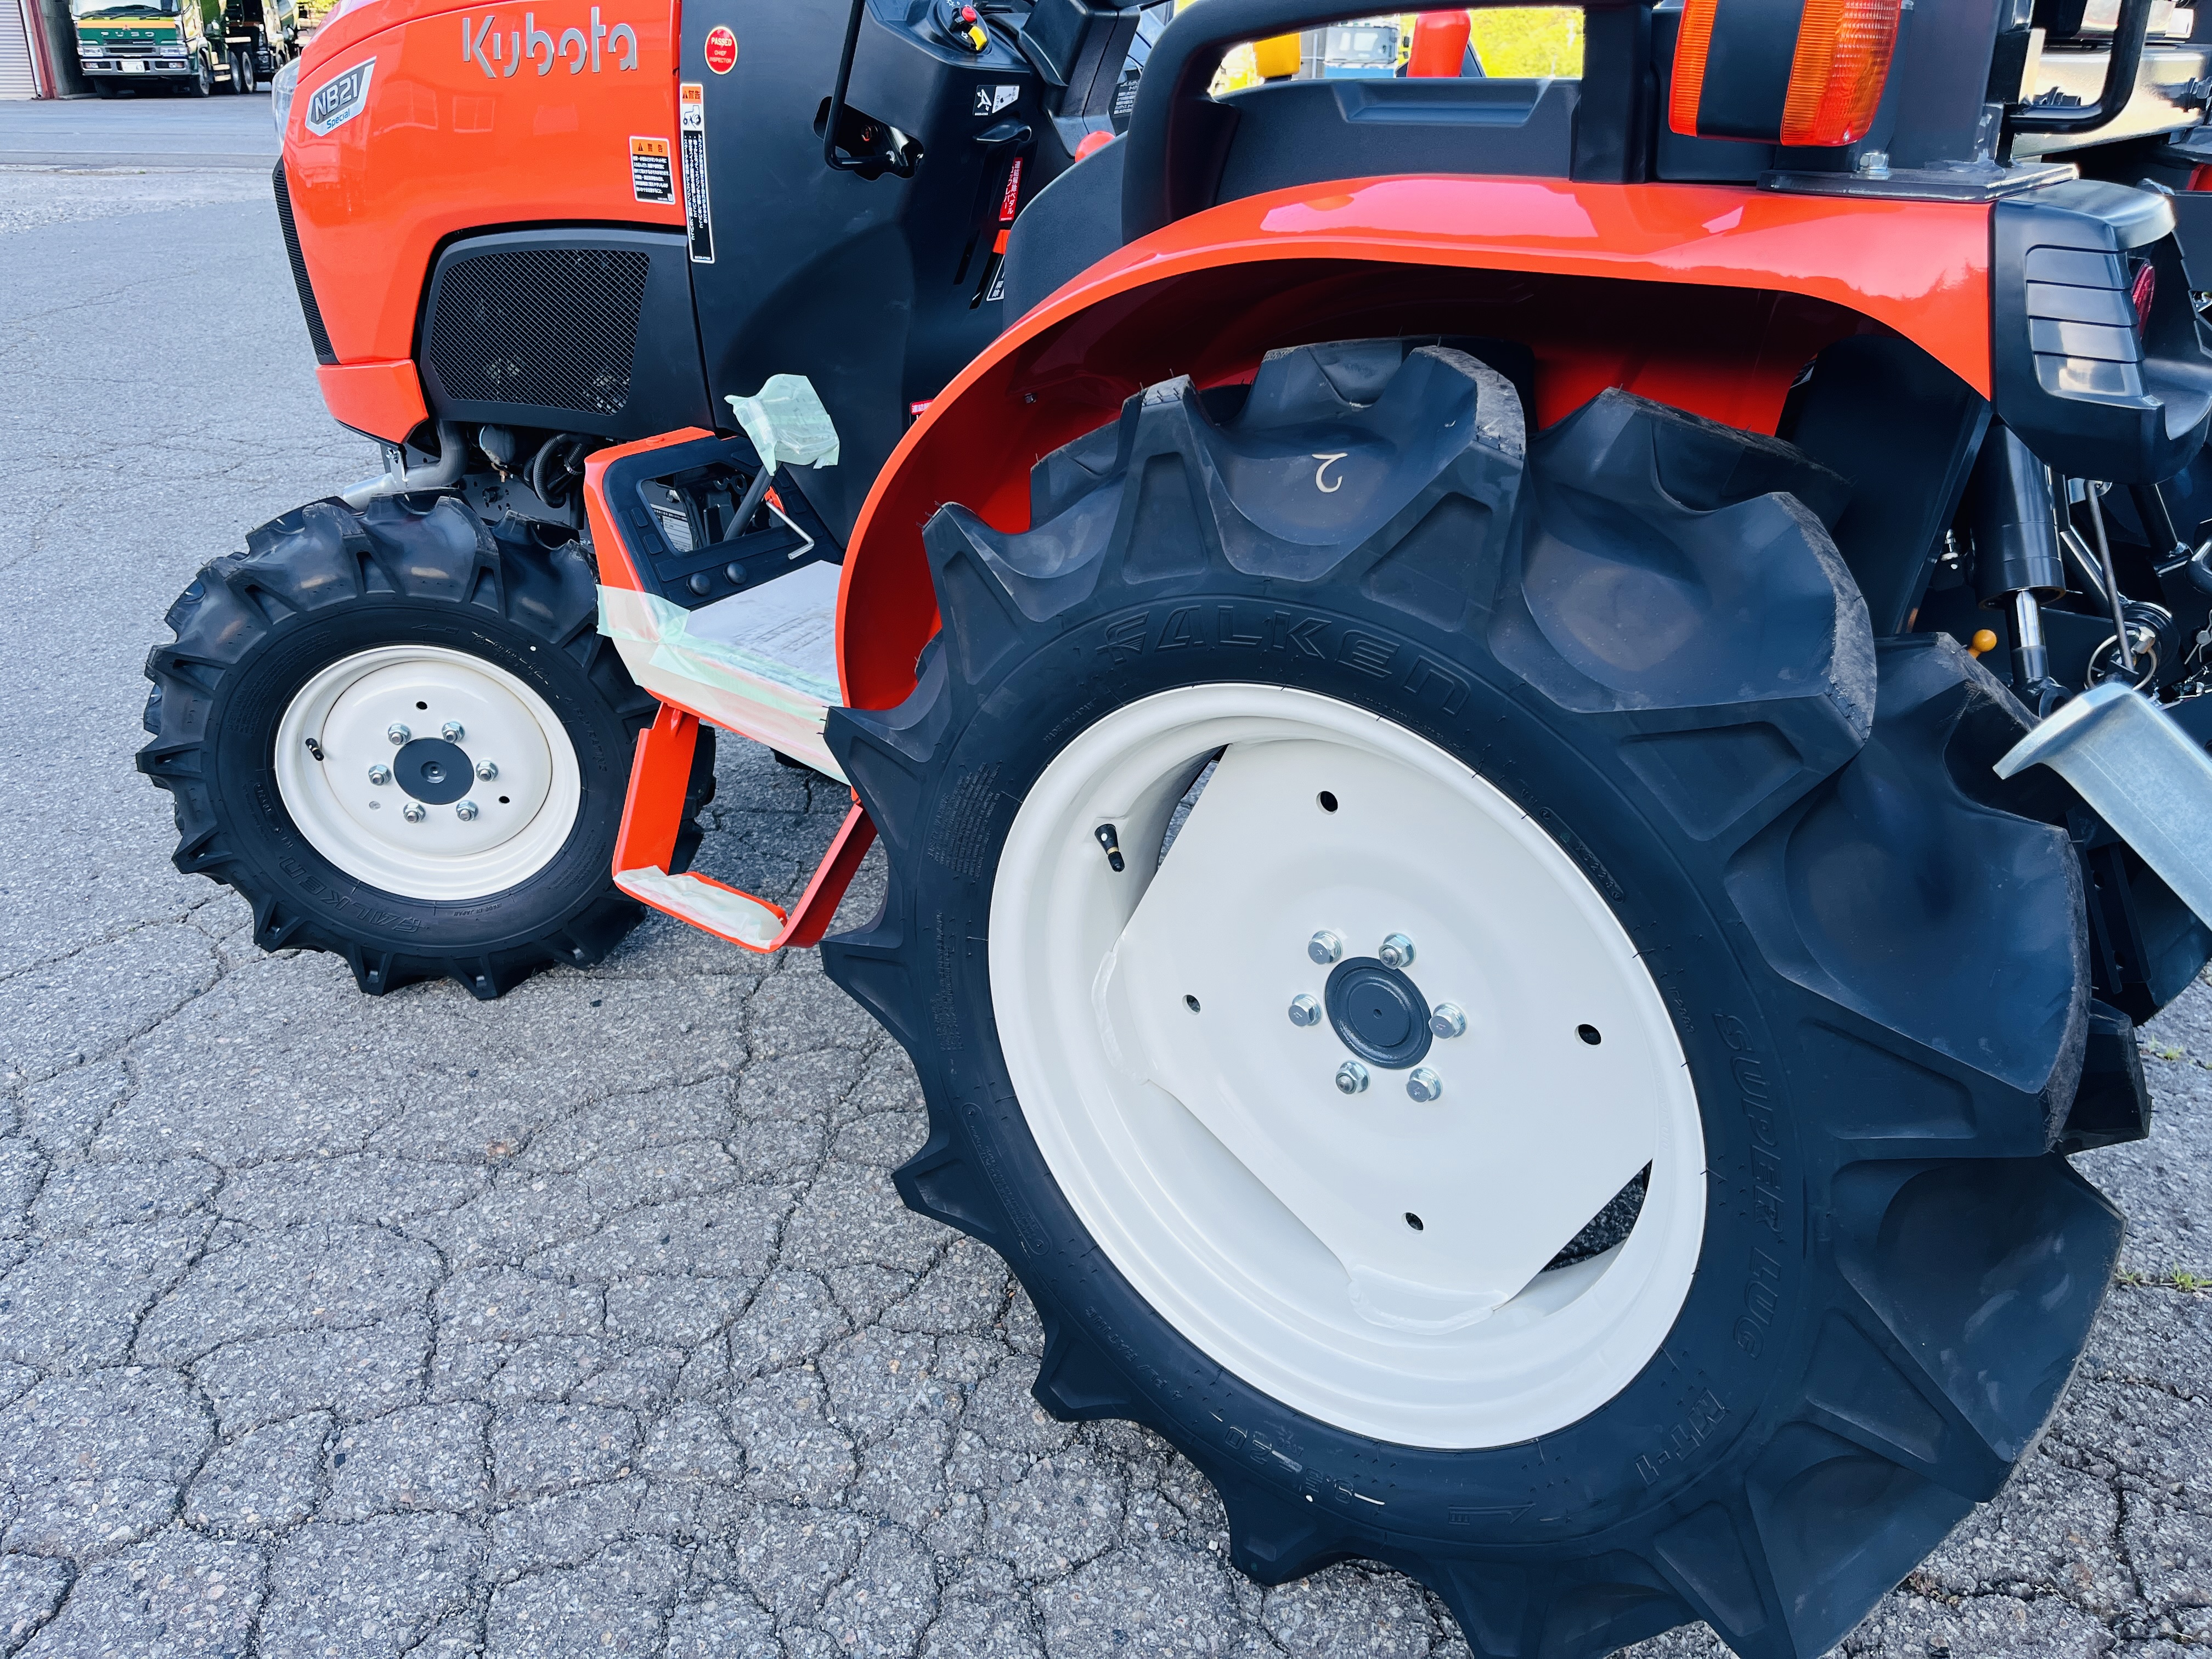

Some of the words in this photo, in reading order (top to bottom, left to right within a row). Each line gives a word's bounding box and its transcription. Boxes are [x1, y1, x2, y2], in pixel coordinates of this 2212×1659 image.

[462, 6, 638, 79] Kubota
[711, 37, 732, 47] PASSED
[315, 73, 358, 122] NB21
[326, 108, 351, 129] Special
[1097, 605, 1471, 719] FALKEN
[278, 856, 422, 935] FALKEN
[1713, 1013, 1786, 1235] SUPER
[1085, 1305, 1137, 1363] RATING
[1734, 1247, 1782, 1360] LUG
